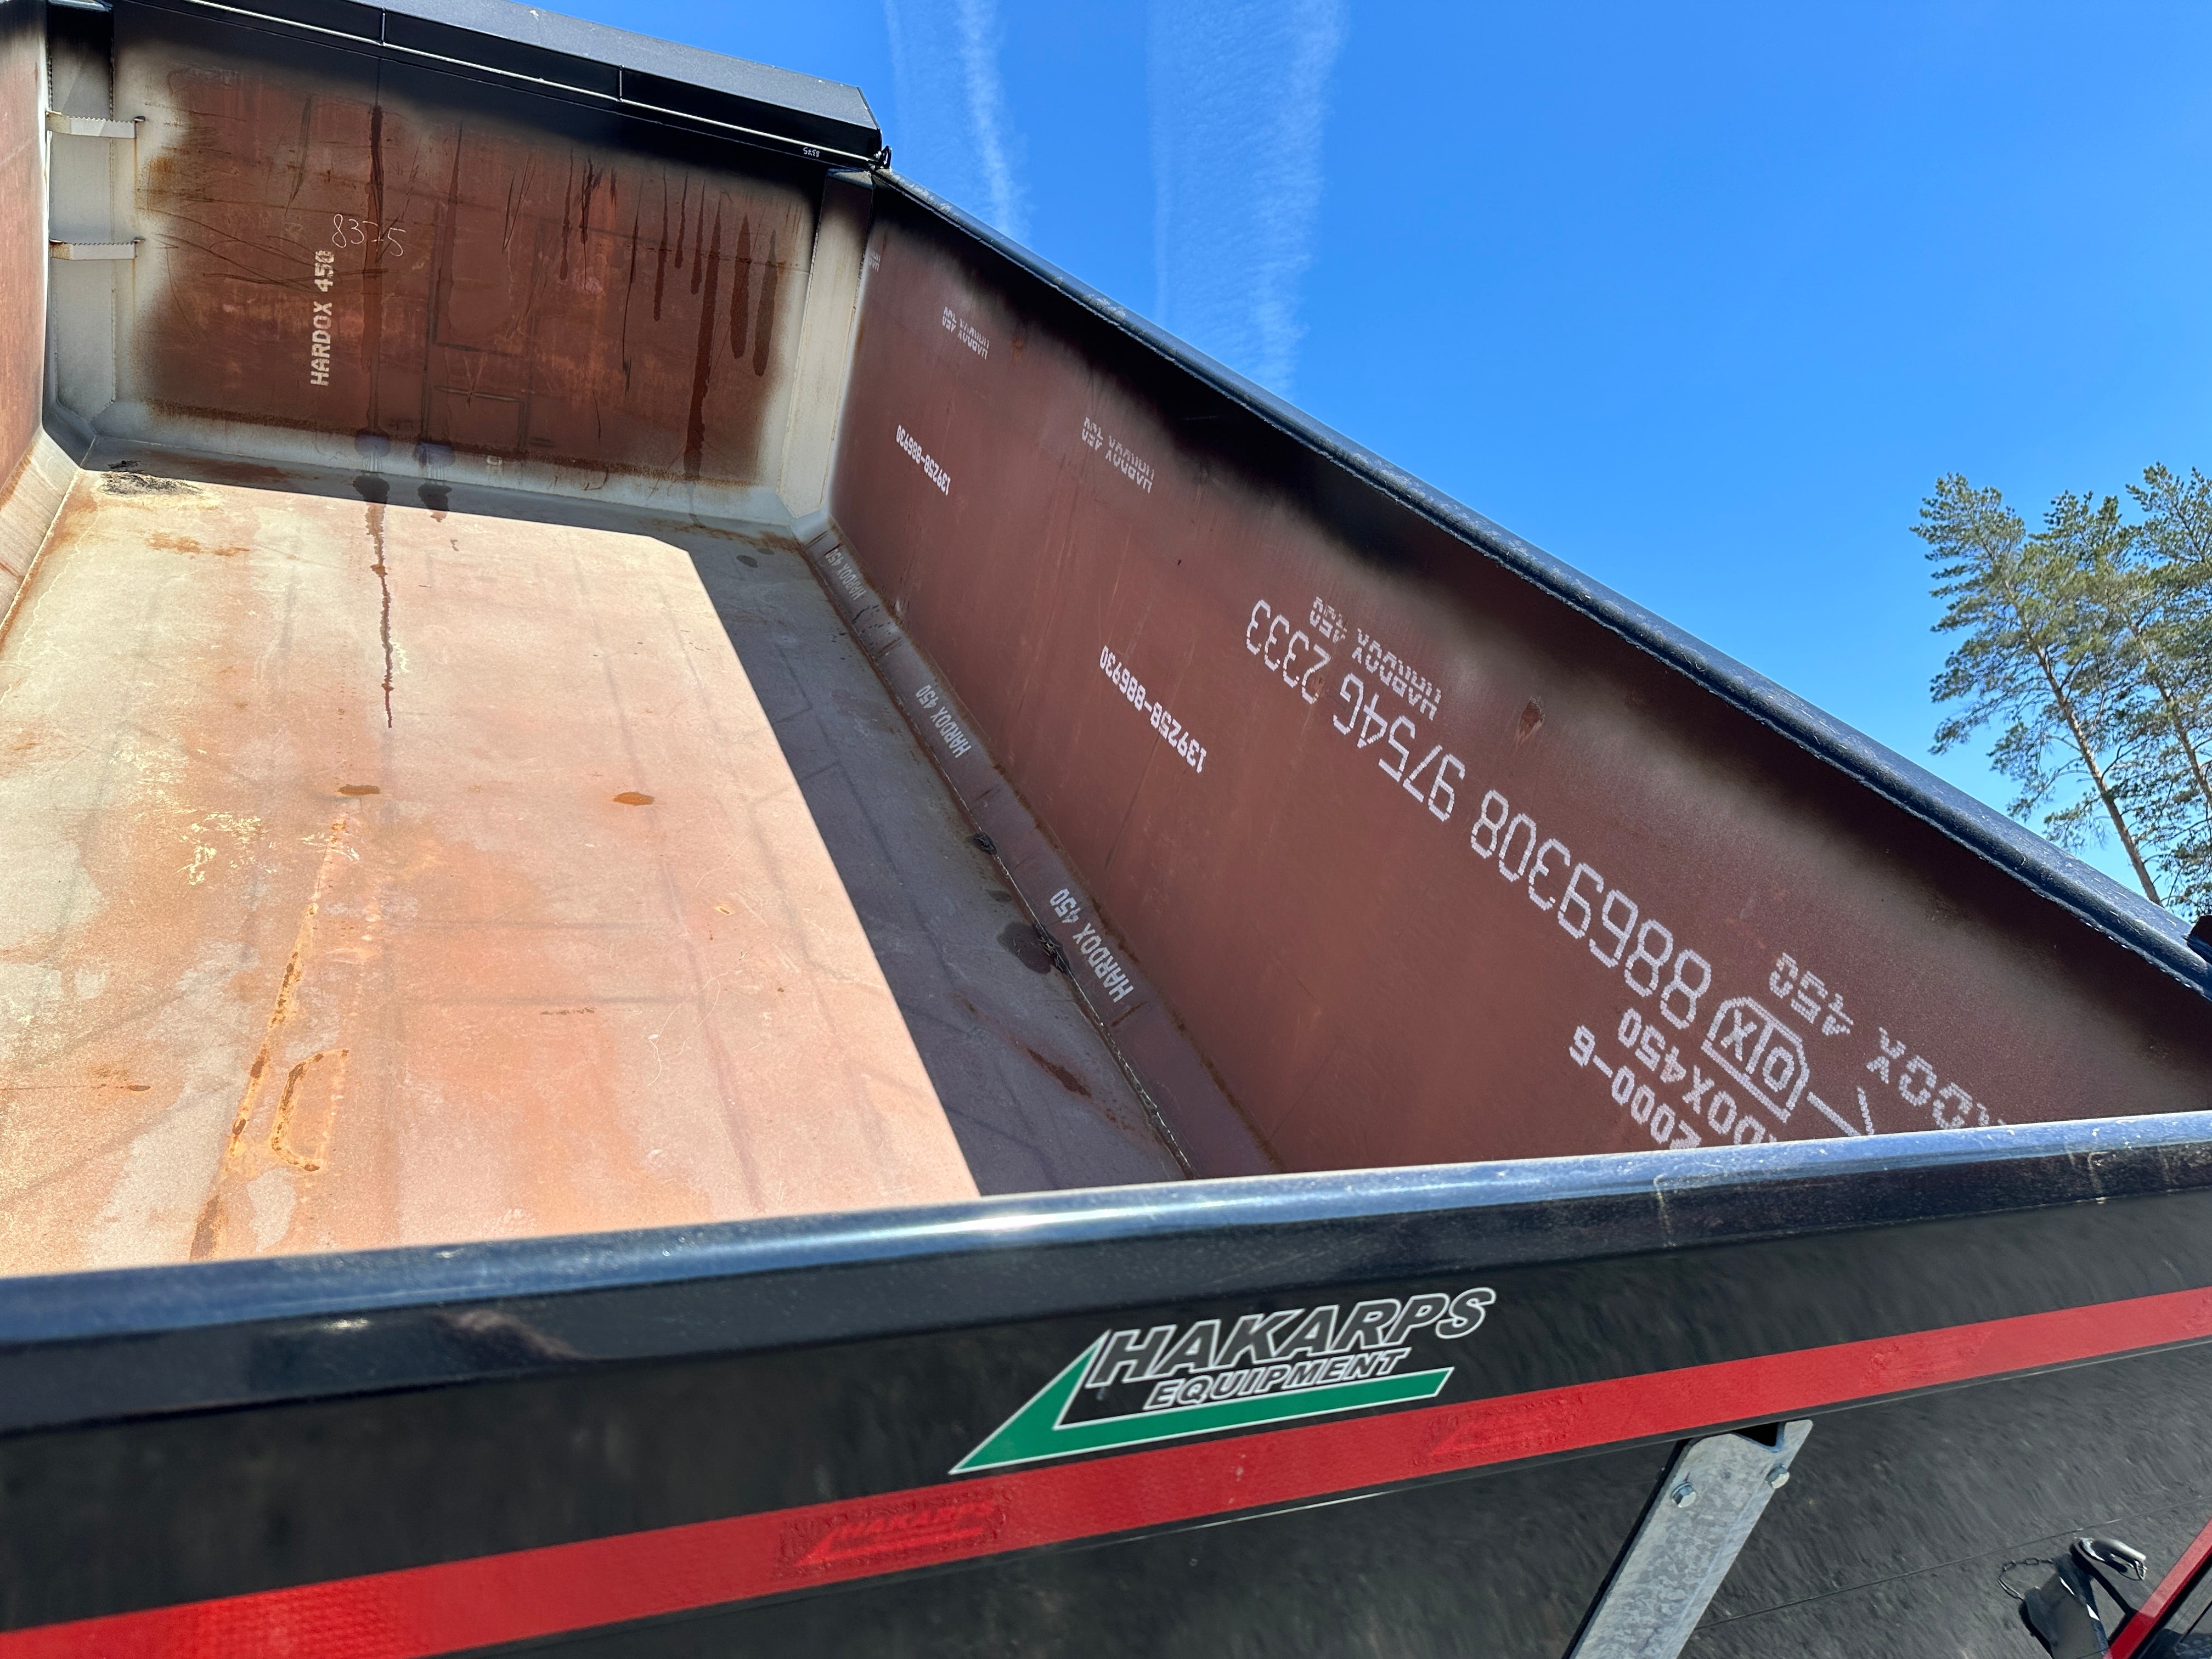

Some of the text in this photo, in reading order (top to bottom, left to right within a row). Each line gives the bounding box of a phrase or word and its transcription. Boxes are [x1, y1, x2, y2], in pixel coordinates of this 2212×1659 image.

[331, 213, 407, 257] 8375
[310, 250, 335, 386] HARDOX 450
[895, 424, 951, 496] 139258-886930
[825, 548, 867, 601] HARDOX 450
[1099, 645, 1207, 774] 139258-886930
[1309, 596, 1442, 721] HARDOX 450
[915, 684, 972, 758] HARDOX 450
[1246, 599, 1712, 1029] 8869308 9754G 2333
[1049, 888, 1134, 1003] HARDOX 450
[1618, 1007, 1777, 1145] DOX450
[1769, 952, 2007, 1130] DOX 450
[1085, 1286, 1497, 1389] HAKARPS
[1142, 1346, 1413, 1411] EQUIPMENT
